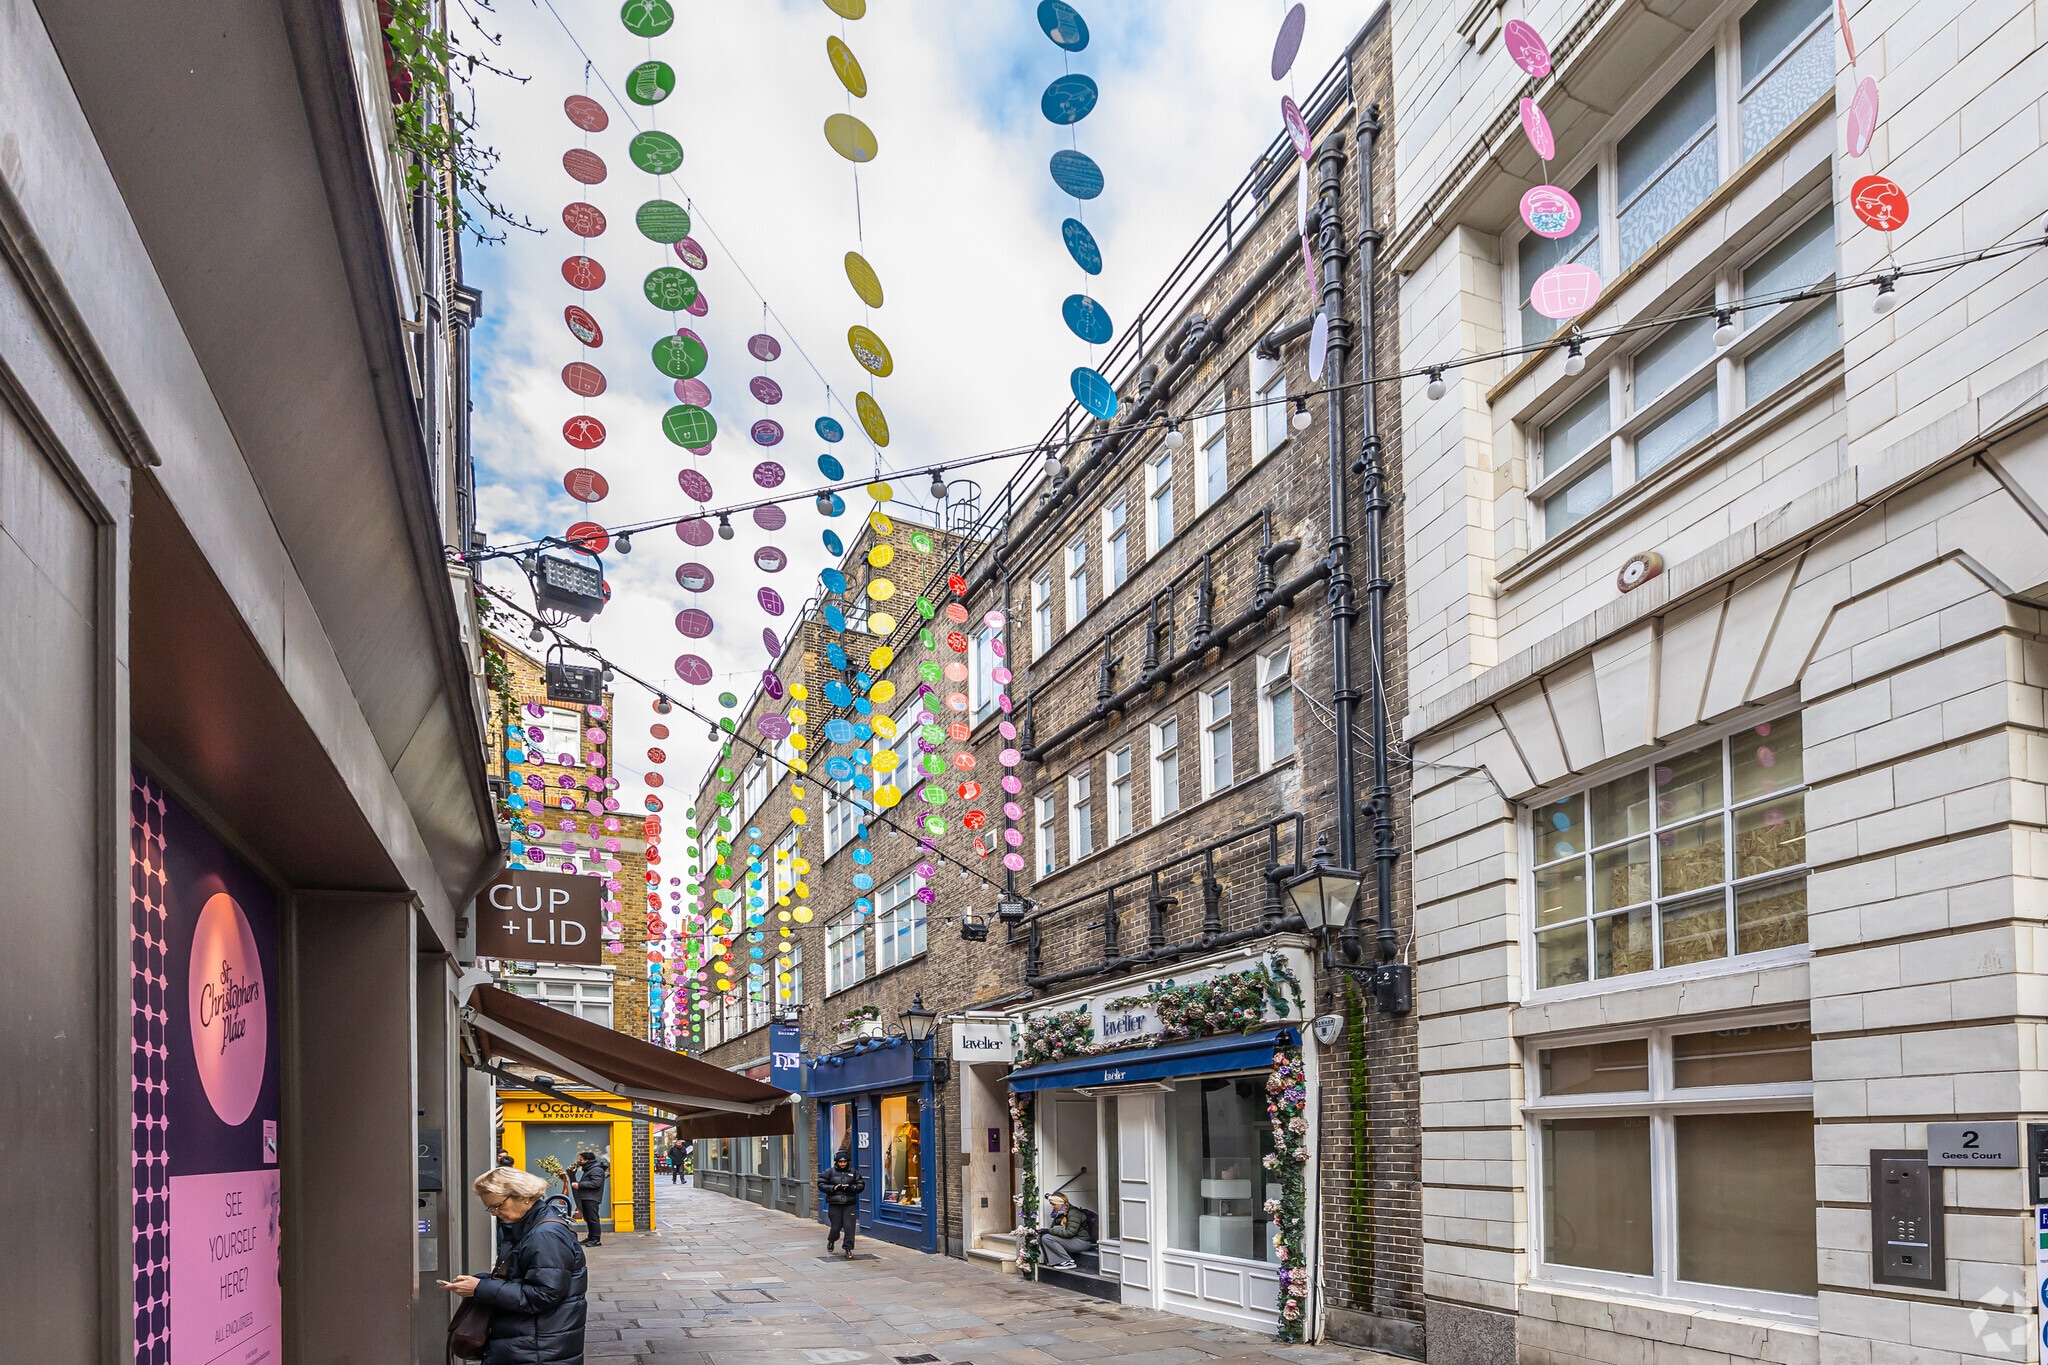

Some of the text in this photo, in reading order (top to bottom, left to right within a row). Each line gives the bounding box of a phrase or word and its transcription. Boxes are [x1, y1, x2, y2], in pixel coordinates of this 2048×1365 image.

[488, 883, 570, 914] CUP
[502, 917, 587, 946] +LID
[219, 959, 232, 985] St
[1383, 972, 1390, 980] 2
[200, 976, 259, 1028] Christopher's
[220, 1013, 246, 1055] Place
[1102, 1010, 1146, 1037] lavelier
[961, 1036, 1003, 1050] lavelier
[1103, 1068, 1126, 1082] lavelier
[1961, 1130, 1979, 1149] 2
[1941, 1152, 2002, 1160] Gees Court
[225, 1191, 243, 1218] SEE
[208, 1226, 257, 1263] YOURSELF
[220, 1266, 249, 1301] HERE?
[214, 1326, 226, 1344] ALL
